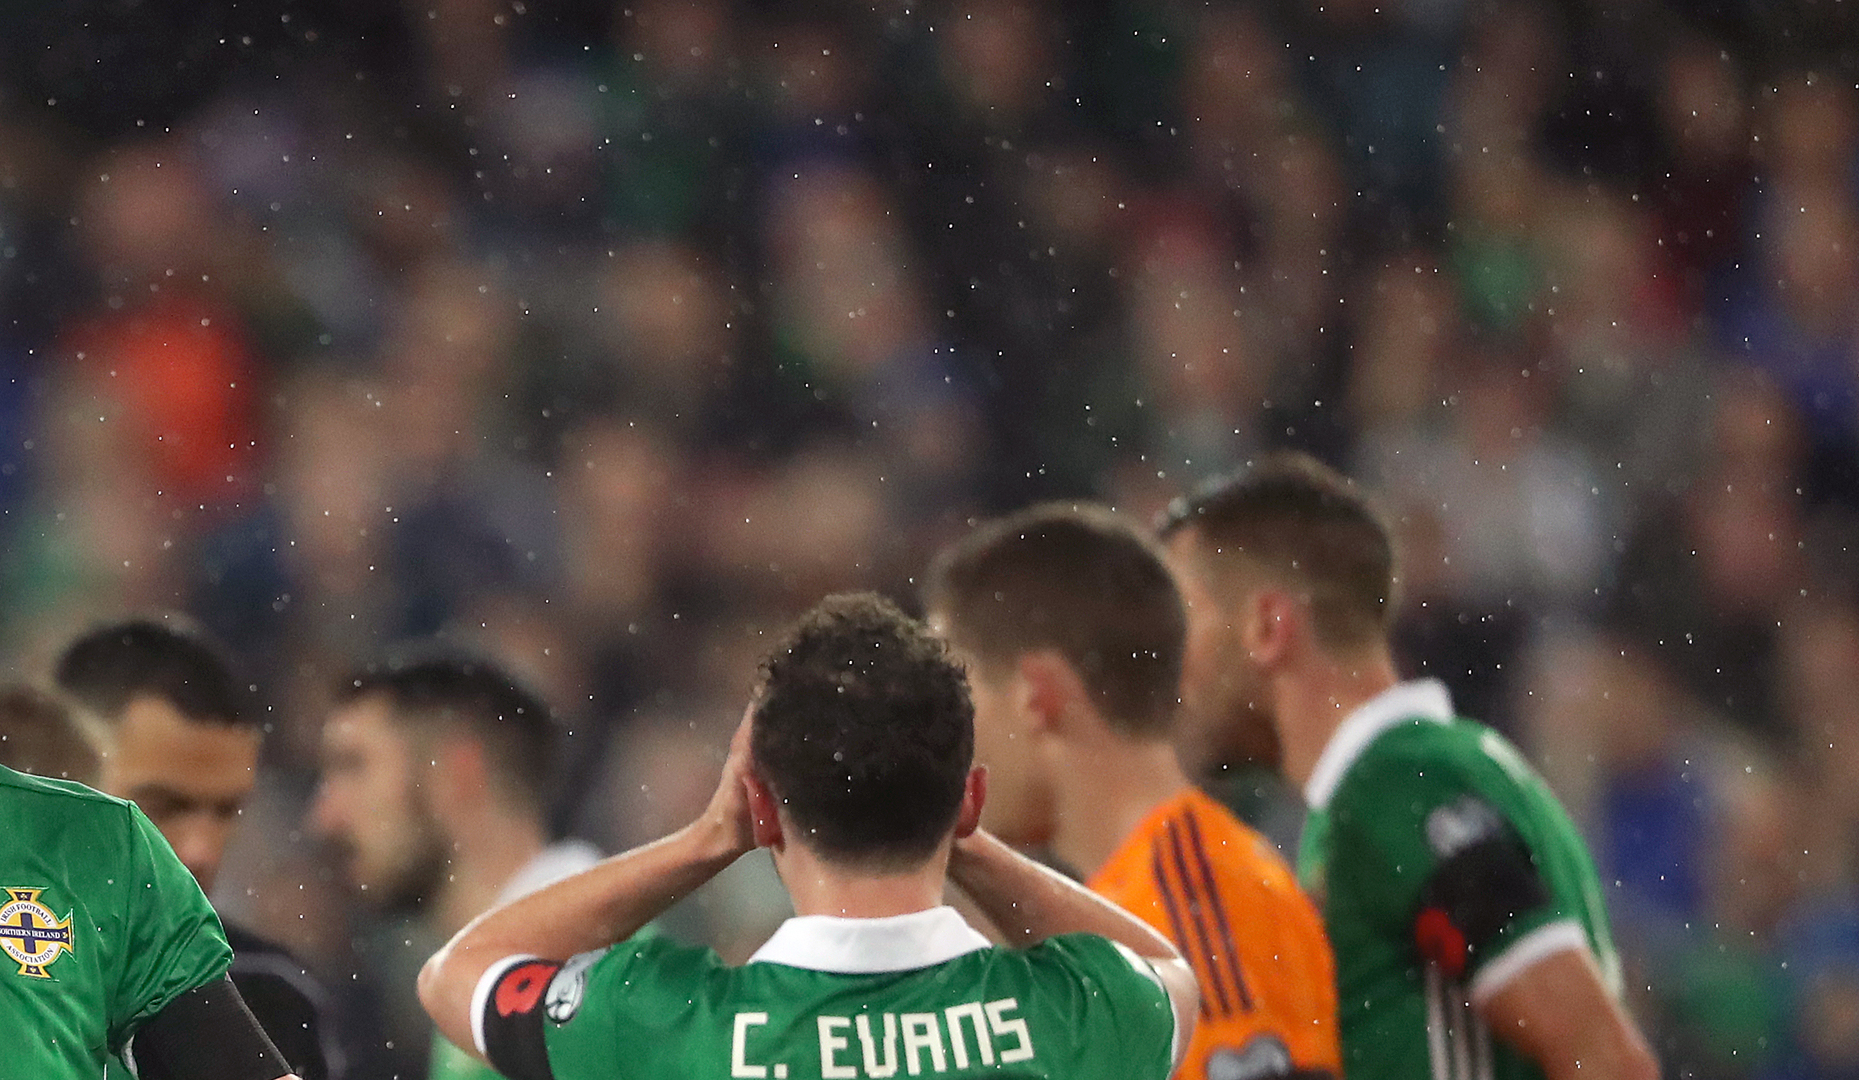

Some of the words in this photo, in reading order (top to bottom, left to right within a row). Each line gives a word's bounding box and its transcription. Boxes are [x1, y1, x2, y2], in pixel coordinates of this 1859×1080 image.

[1, 905, 16, 923] IRISH
[16, 903, 52, 926] FOOTBALL
[32, 930, 61, 939] IRELAND
[6, 944, 54, 964] ASSOCIATION
[731, 1011, 788, 1079] C.
[818, 998, 1035, 1080] EVANS
